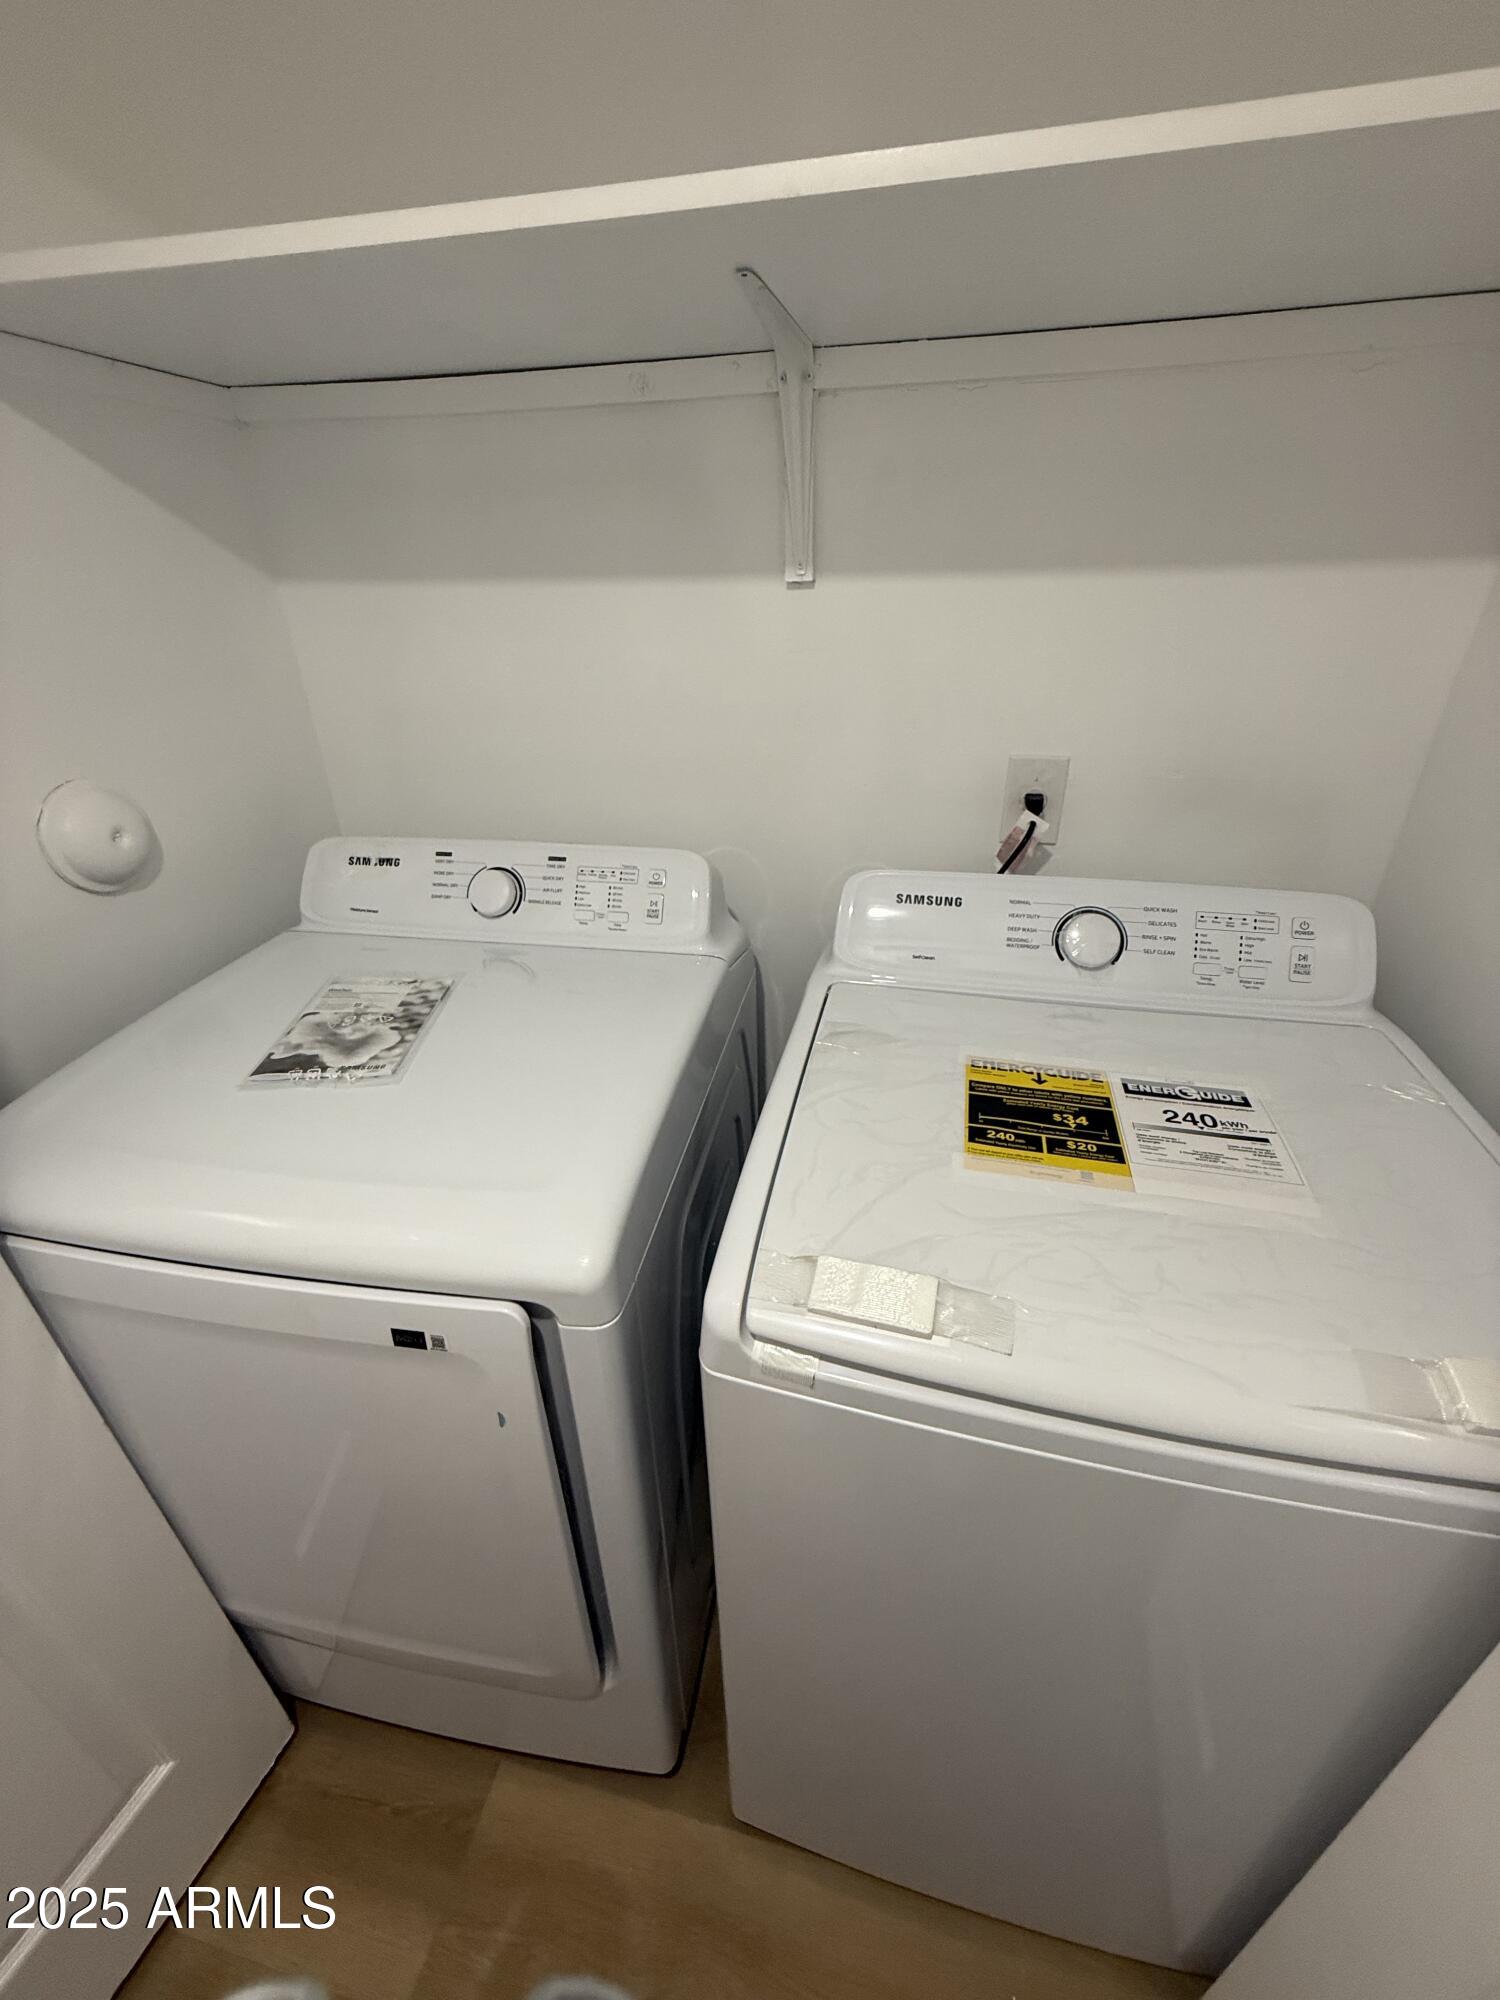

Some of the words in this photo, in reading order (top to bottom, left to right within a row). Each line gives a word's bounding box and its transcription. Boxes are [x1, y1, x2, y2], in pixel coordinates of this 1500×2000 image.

[896, 893, 963, 907] SAMSUNG
[1126, 1082, 1245, 1103] ENERGUIDE
[1052, 1113, 1089, 1126] $34
[1162, 1109, 1218, 1128] 240
[1219, 1119, 1249, 1130] kWh
[986, 1130, 1015, 1142] 240
[1066, 1140, 1097, 1152] $20
